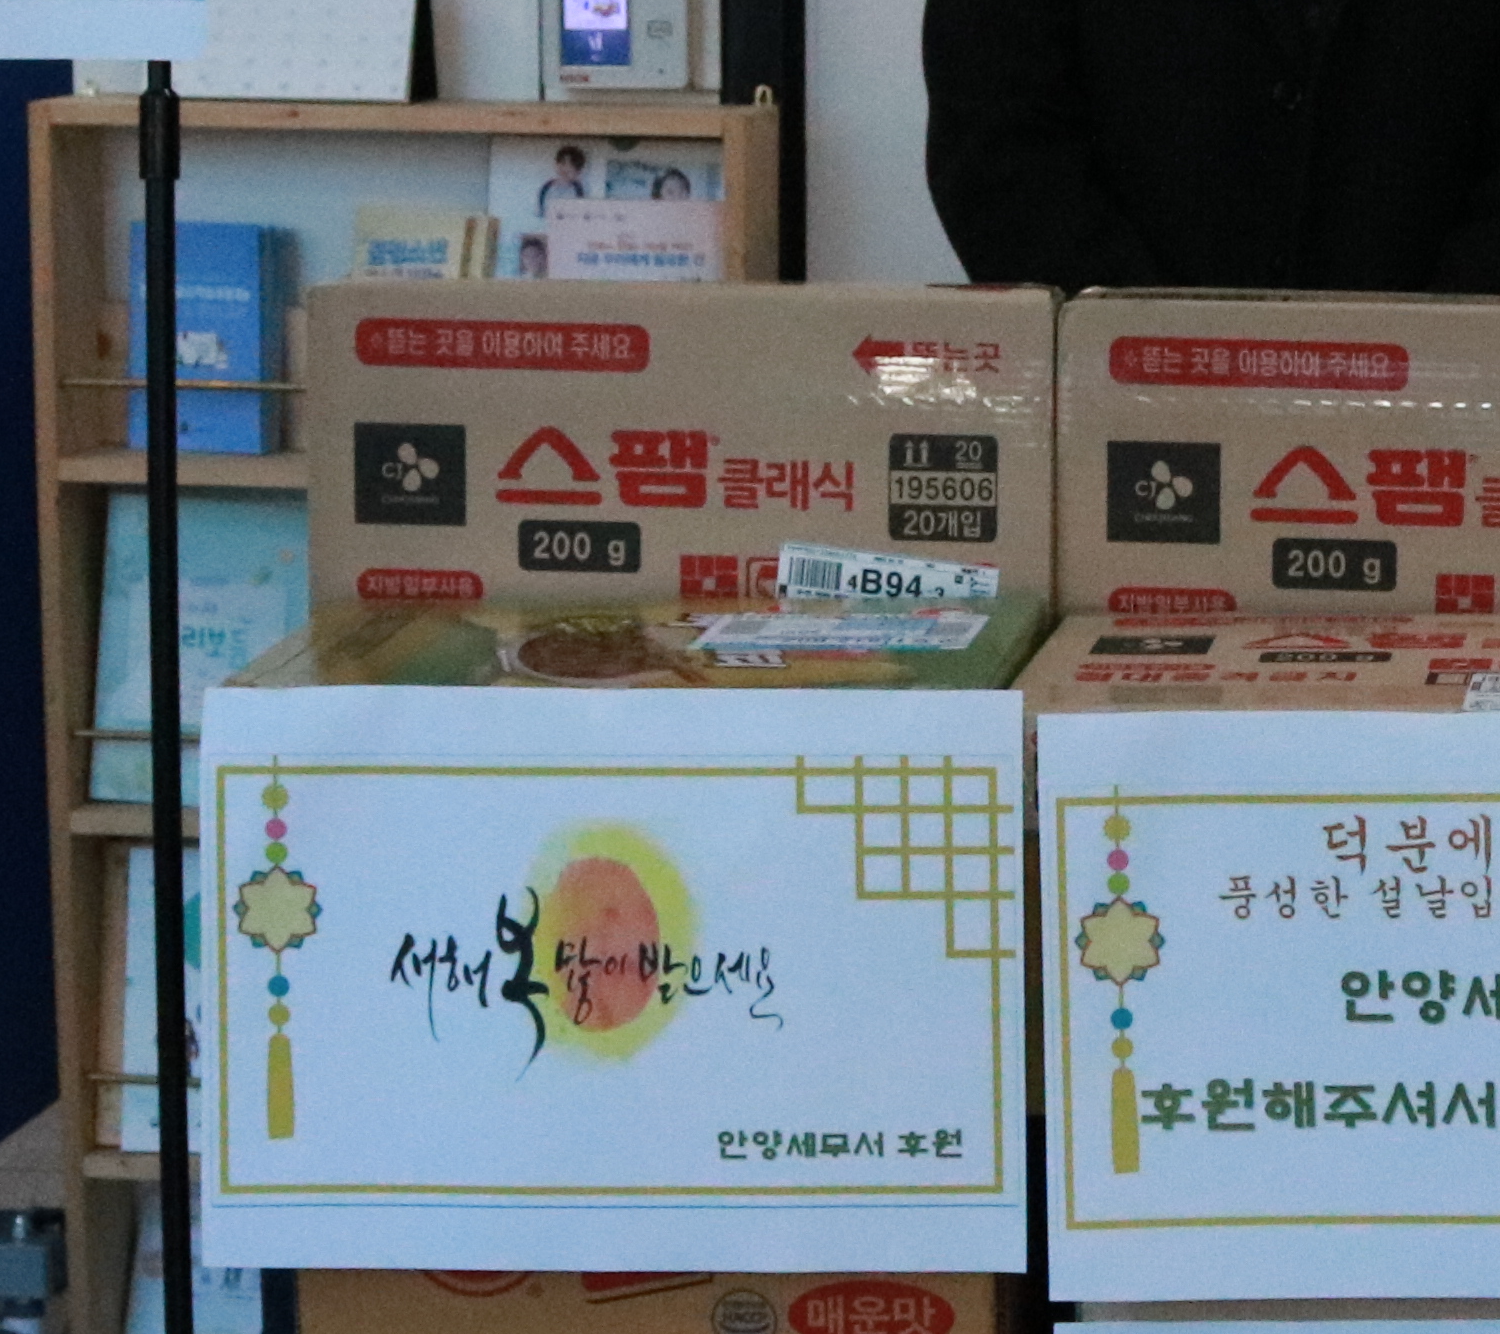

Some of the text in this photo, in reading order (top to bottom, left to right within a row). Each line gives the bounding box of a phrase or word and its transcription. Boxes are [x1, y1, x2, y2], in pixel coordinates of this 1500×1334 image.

[954, 440, 983, 462] 20
[495, 426, 855, 513] 스팸 클래식
[1249, 445, 1467, 528] 스팸
[894, 475, 994, 502] 195606
[1134, 479, 1157, 499] CJ
[902, 510, 982, 539] 20개입
[532, 530, 627, 567] 200 g
[1287, 549, 1382, 585] 200 g
[1218, 874, 1351, 922] 풍성한
[1140, 1078, 1498, 1134] 후원해주셔서
[716, 1128, 965, 1160] 안양세무서 후원
